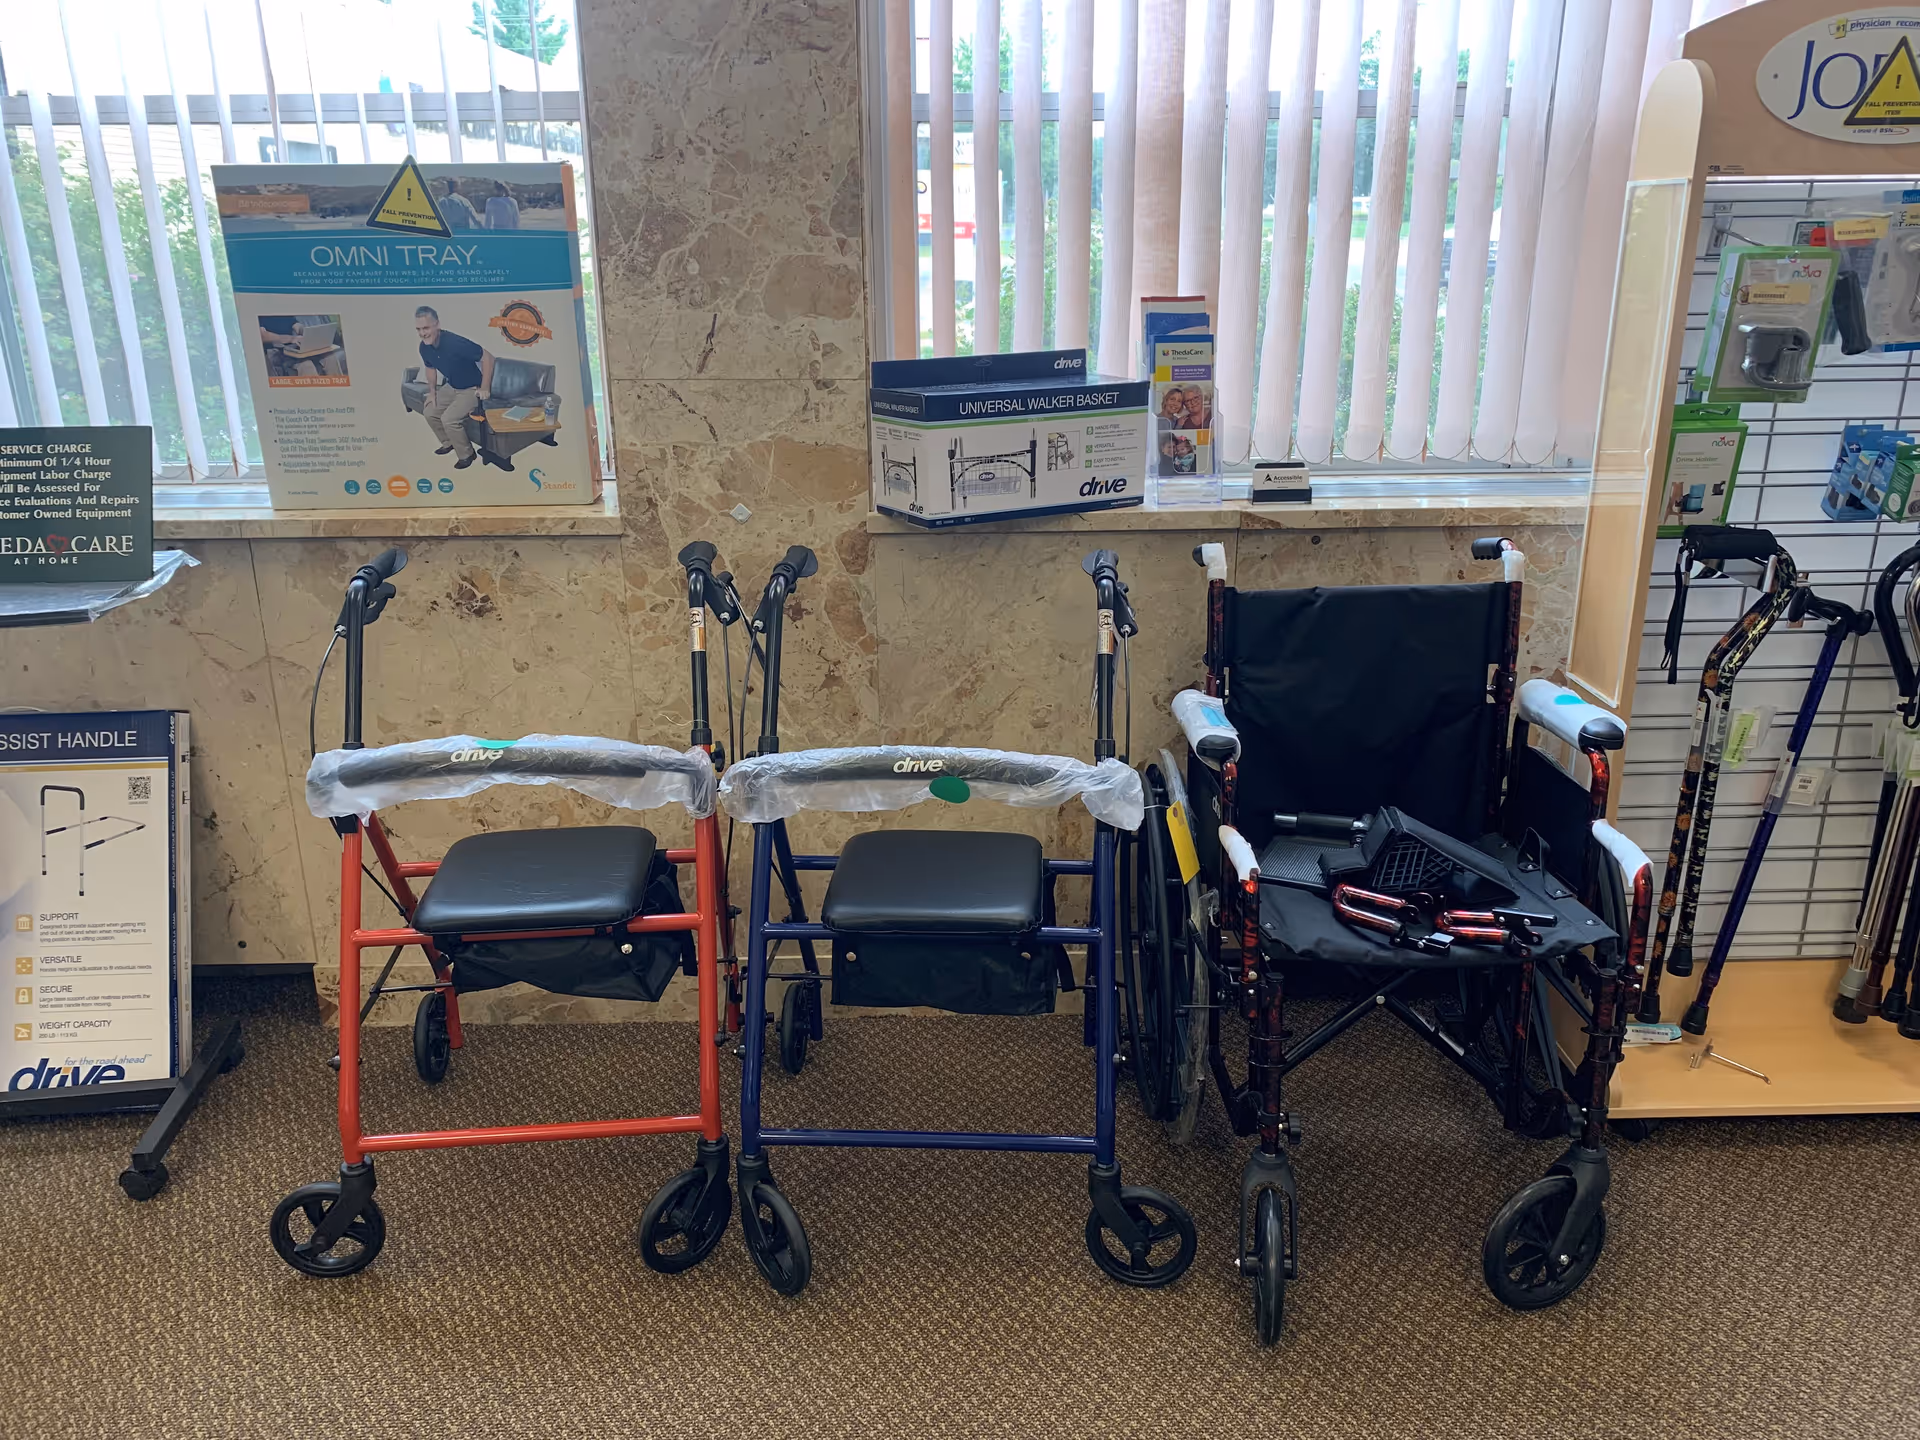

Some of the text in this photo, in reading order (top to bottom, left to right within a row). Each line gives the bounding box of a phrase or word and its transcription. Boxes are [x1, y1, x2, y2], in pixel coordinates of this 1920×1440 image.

[1850, 19, 1891, 31] physician
[1787, 40, 1889, 120] JO
[382, 208, 436, 221] FALL PREVENTION
[310, 244, 478, 267] OMNI TRAY
[1792, 268, 1822, 278] nova
[1054, 357, 1082, 370] drive
[959, 392, 1120, 415] UNIVERSAL WALKER BASKET
[1711, 439, 1735, 447] nova
[0, 444, 92, 455] SERVICE CHARGE
[43, 457, 57, 467] Of
[60, 457, 81, 467] 1/4
[84, 456, 111, 466] Hour
[0, 469, 112, 483] ipment Labor Charge
[17, 484, 30, 493] Be
[34, 482, 80, 493] Assessed
[84, 482, 100, 492] For
[543, 481, 577, 490] Stander
[1079, 476, 1127, 497] drive
[14, 496, 71, 506] Evaluations
[75, 495, 97, 505] And
[100, 494, 140, 507] Repairs
[908, 501, 923, 514] drive
[33, 509, 72, 518] Owned
[75, 508, 132, 520] Equipment
[0, 535, 134, 556] EDA CARE
[14, 557, 78, 565] AT HOME
[58, 730, 137, 748] HANDLE
[450, 747, 504, 763] drive
[892, 756, 945, 774] drive
[39, 912, 79, 921] SUPPORT
[40, 955, 82, 964] VERSATILE
[39, 985, 73, 994] SECURE
[38, 1020, 112, 1029] WEIGHT CAPACITY
[64, 1056, 77, 1066] for
[80, 1056, 94, 1065] the
[96, 1055, 118, 1065] road
[8, 1058, 126, 1091] drive
